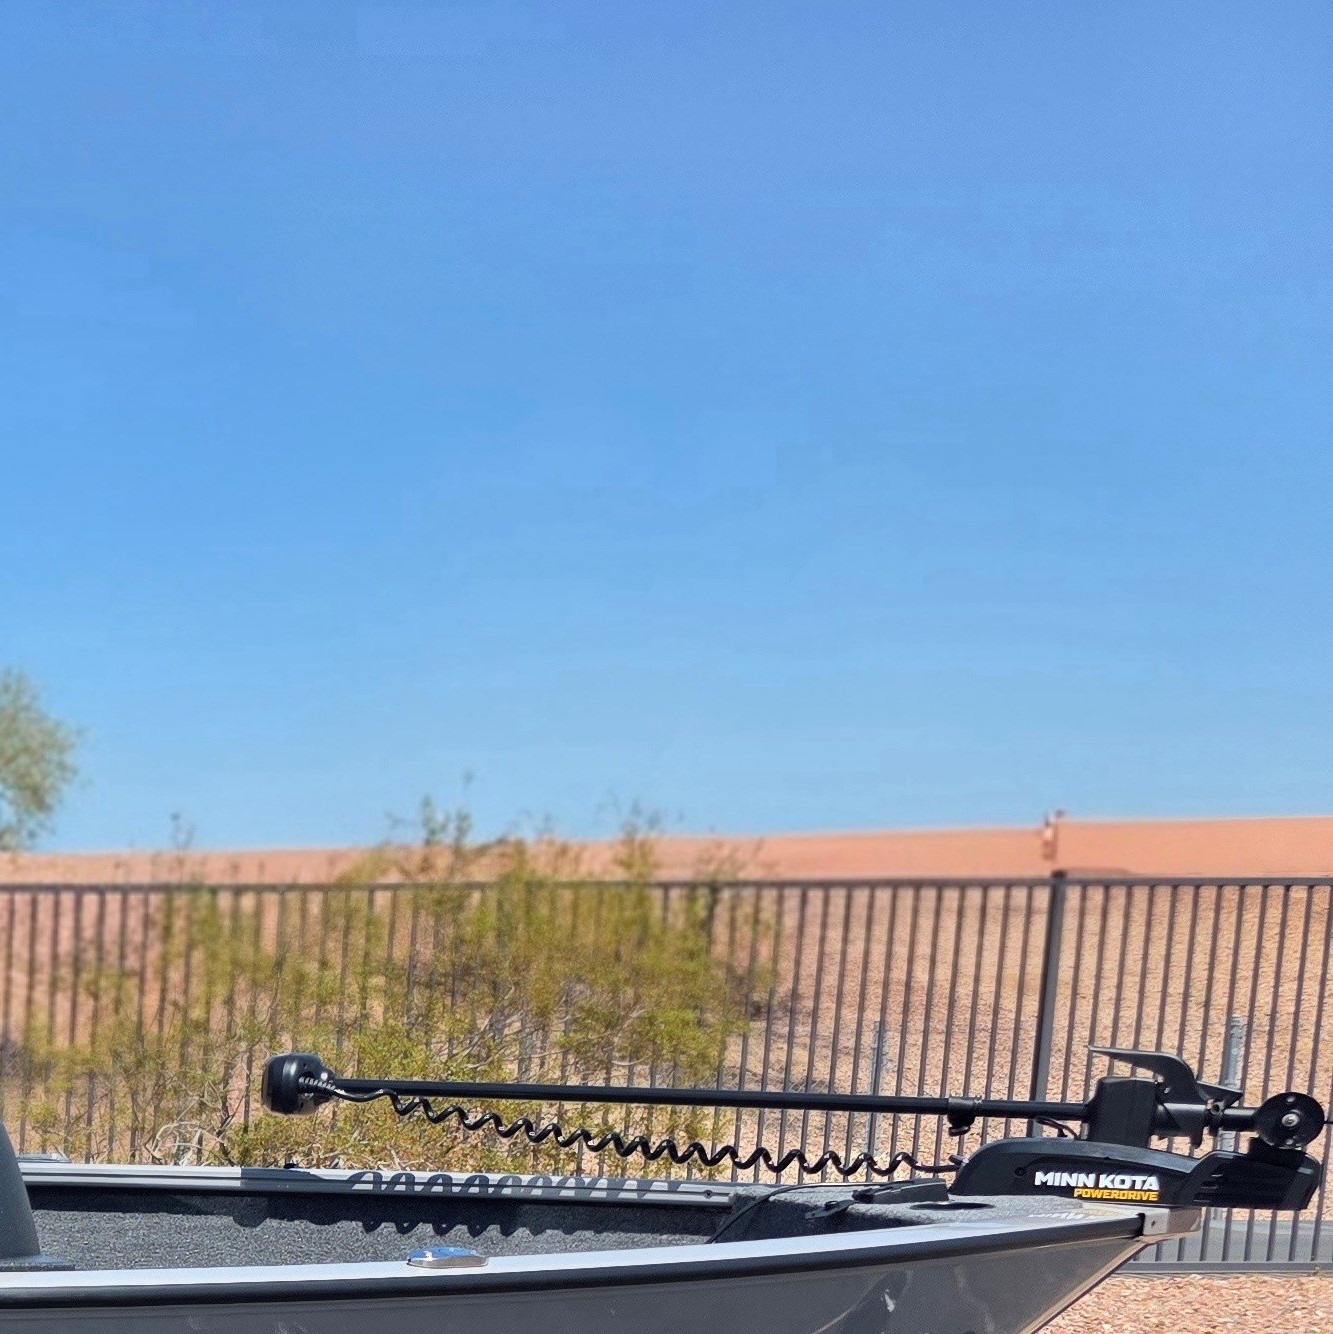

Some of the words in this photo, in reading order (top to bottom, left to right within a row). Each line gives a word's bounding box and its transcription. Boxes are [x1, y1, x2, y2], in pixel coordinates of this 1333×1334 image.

[1034, 1171, 1096, 1187] MINN
[1098, 1173, 1160, 1190] KOTA
[1073, 1188, 1159, 1201] POWERDRIVE
